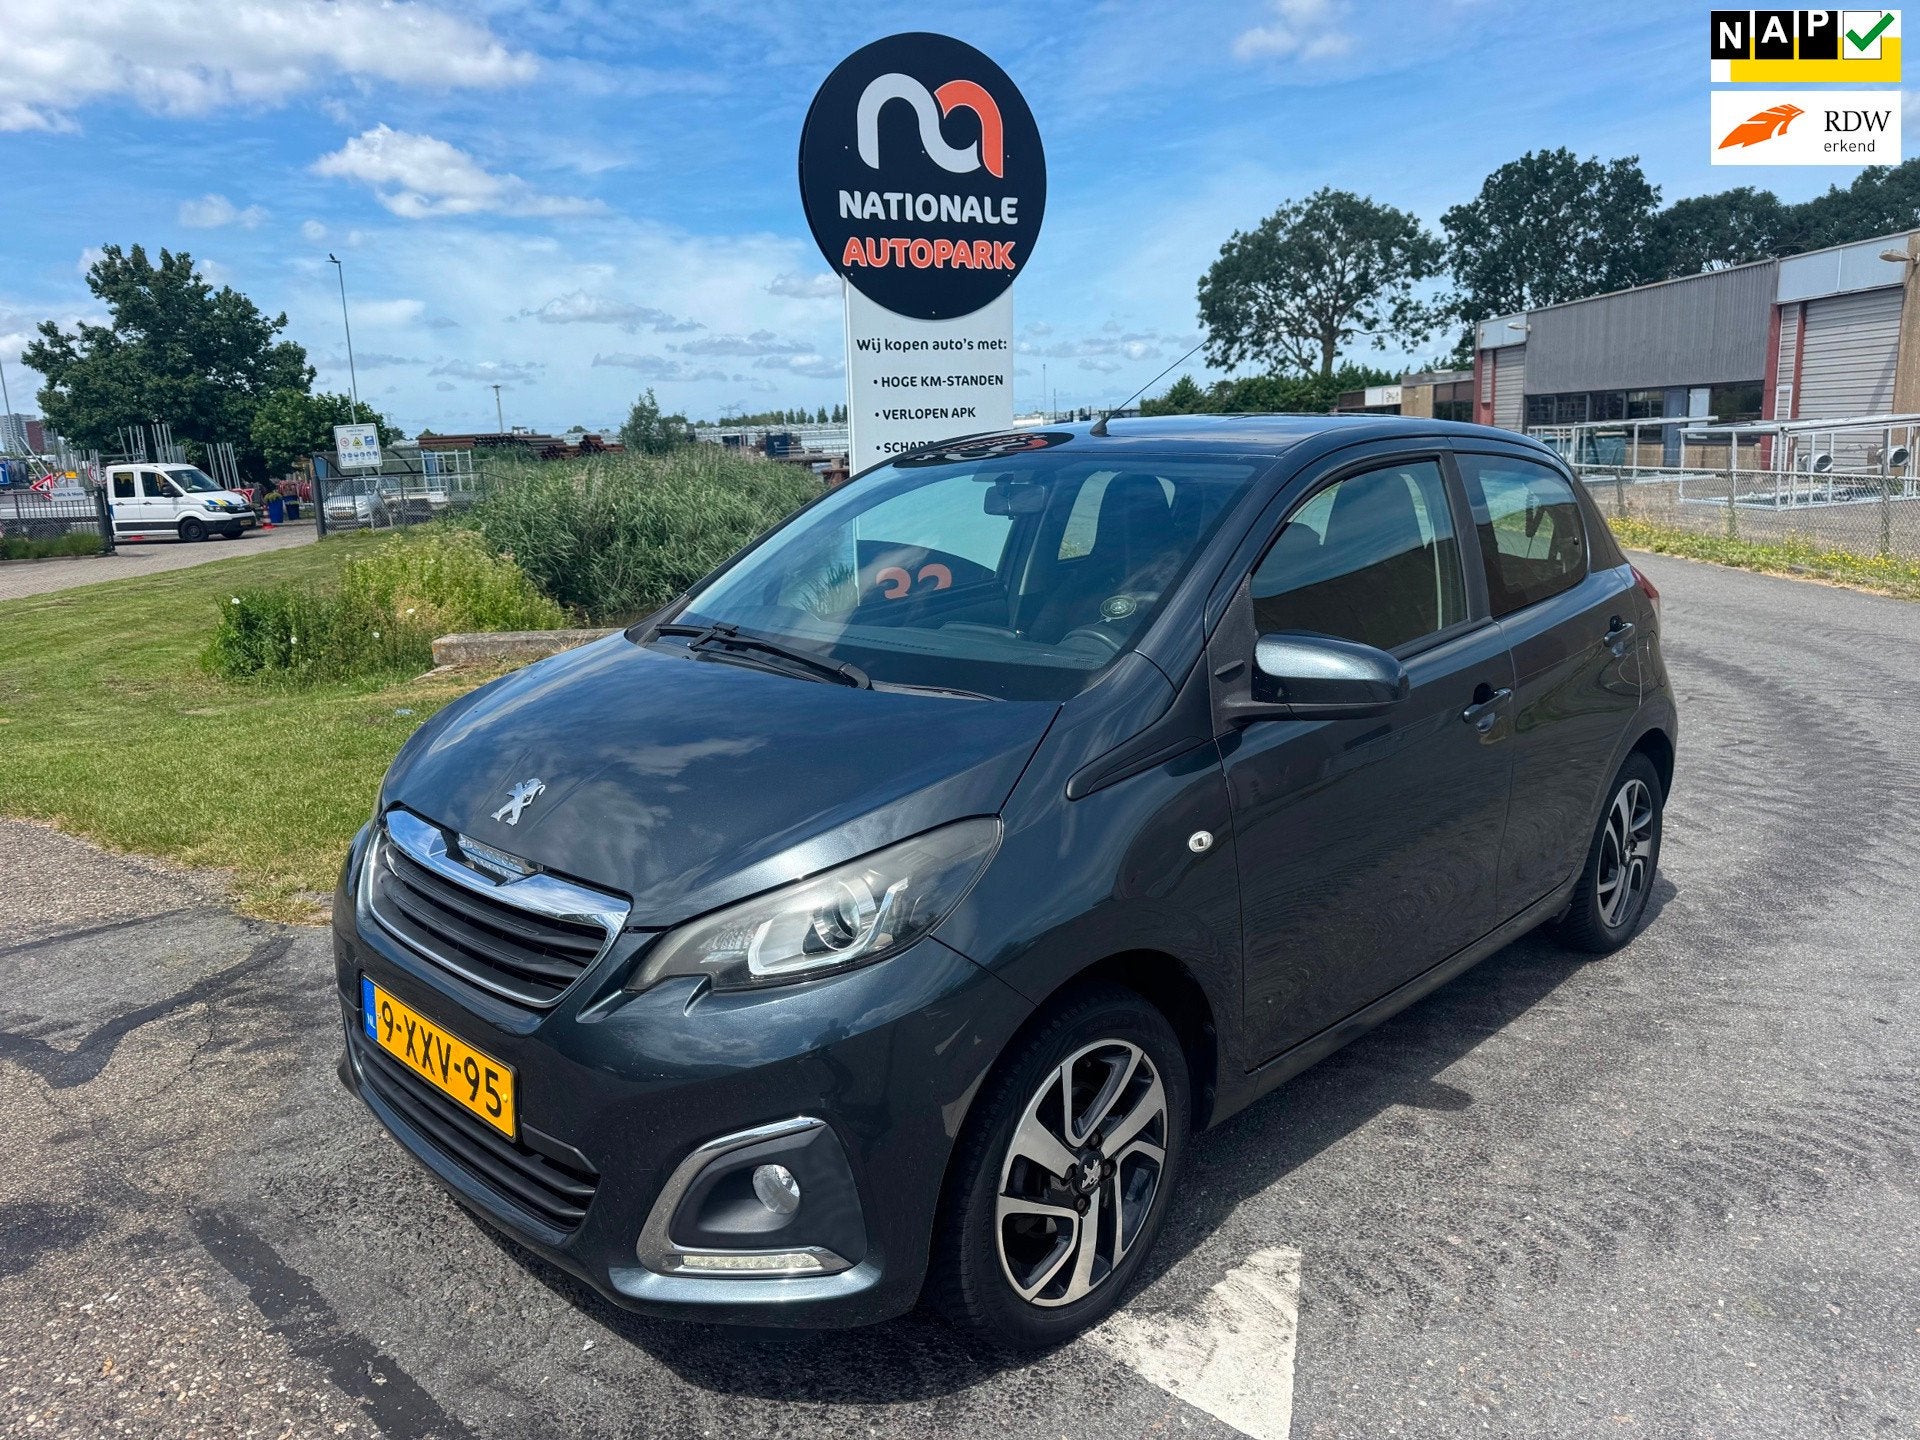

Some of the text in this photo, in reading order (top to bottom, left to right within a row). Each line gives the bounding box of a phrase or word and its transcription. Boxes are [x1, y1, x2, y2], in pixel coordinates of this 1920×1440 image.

[839, 190, 1018, 225] NATIONALE
[842, 237, 1016, 269] AUTOPARK
[856, 338, 1007, 353] Wij kopen auto's met:
[881, 375, 1004, 388] HOGE KM-STANDEN
[882, 407, 976, 420] VERLOPEN APK
[381, 1000, 502, 1118] 9-XXV-95
